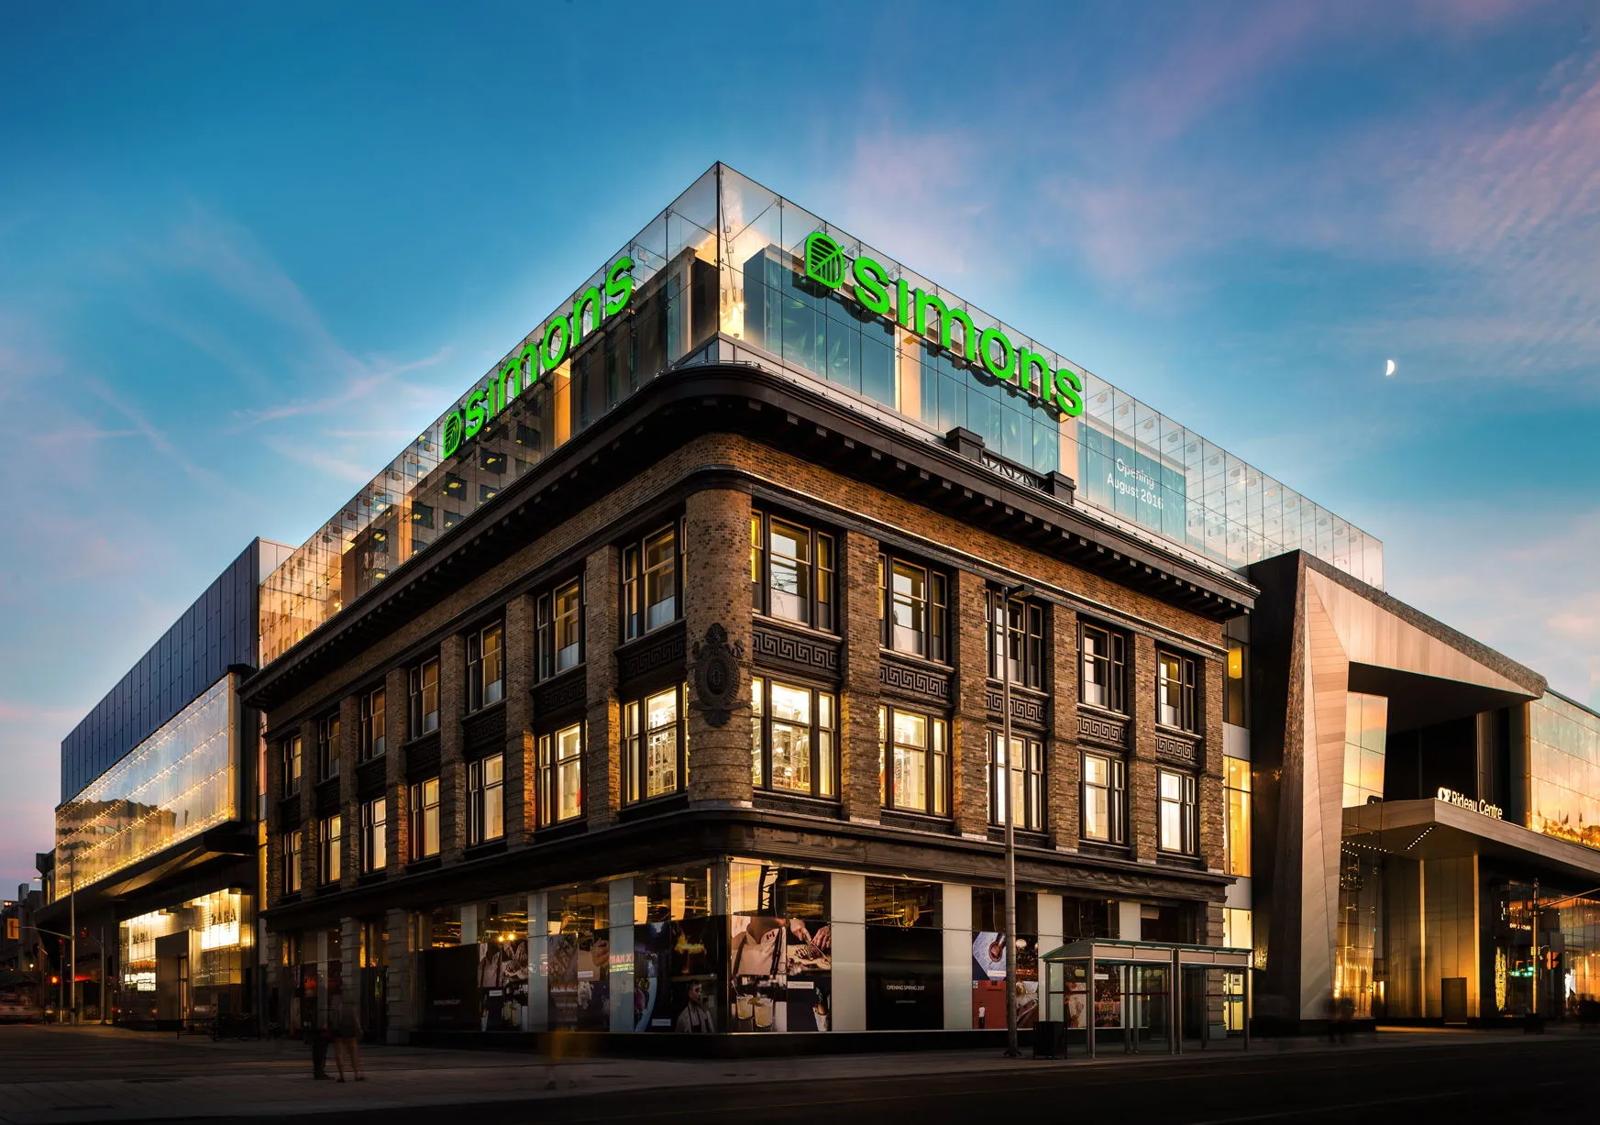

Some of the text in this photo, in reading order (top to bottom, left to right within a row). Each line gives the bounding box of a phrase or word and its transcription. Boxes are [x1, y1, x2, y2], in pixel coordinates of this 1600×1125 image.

[464, 255, 636, 438] simons
[853, 255, 1085, 417] simons
[1106, 472, 1139, 499] August
[1116, 458, 1155, 490] Opening
[1451, 790, 1478, 813] Rideau
[1479, 798, 1503, 820] Centre
[211, 908, 237, 926] ZARA
